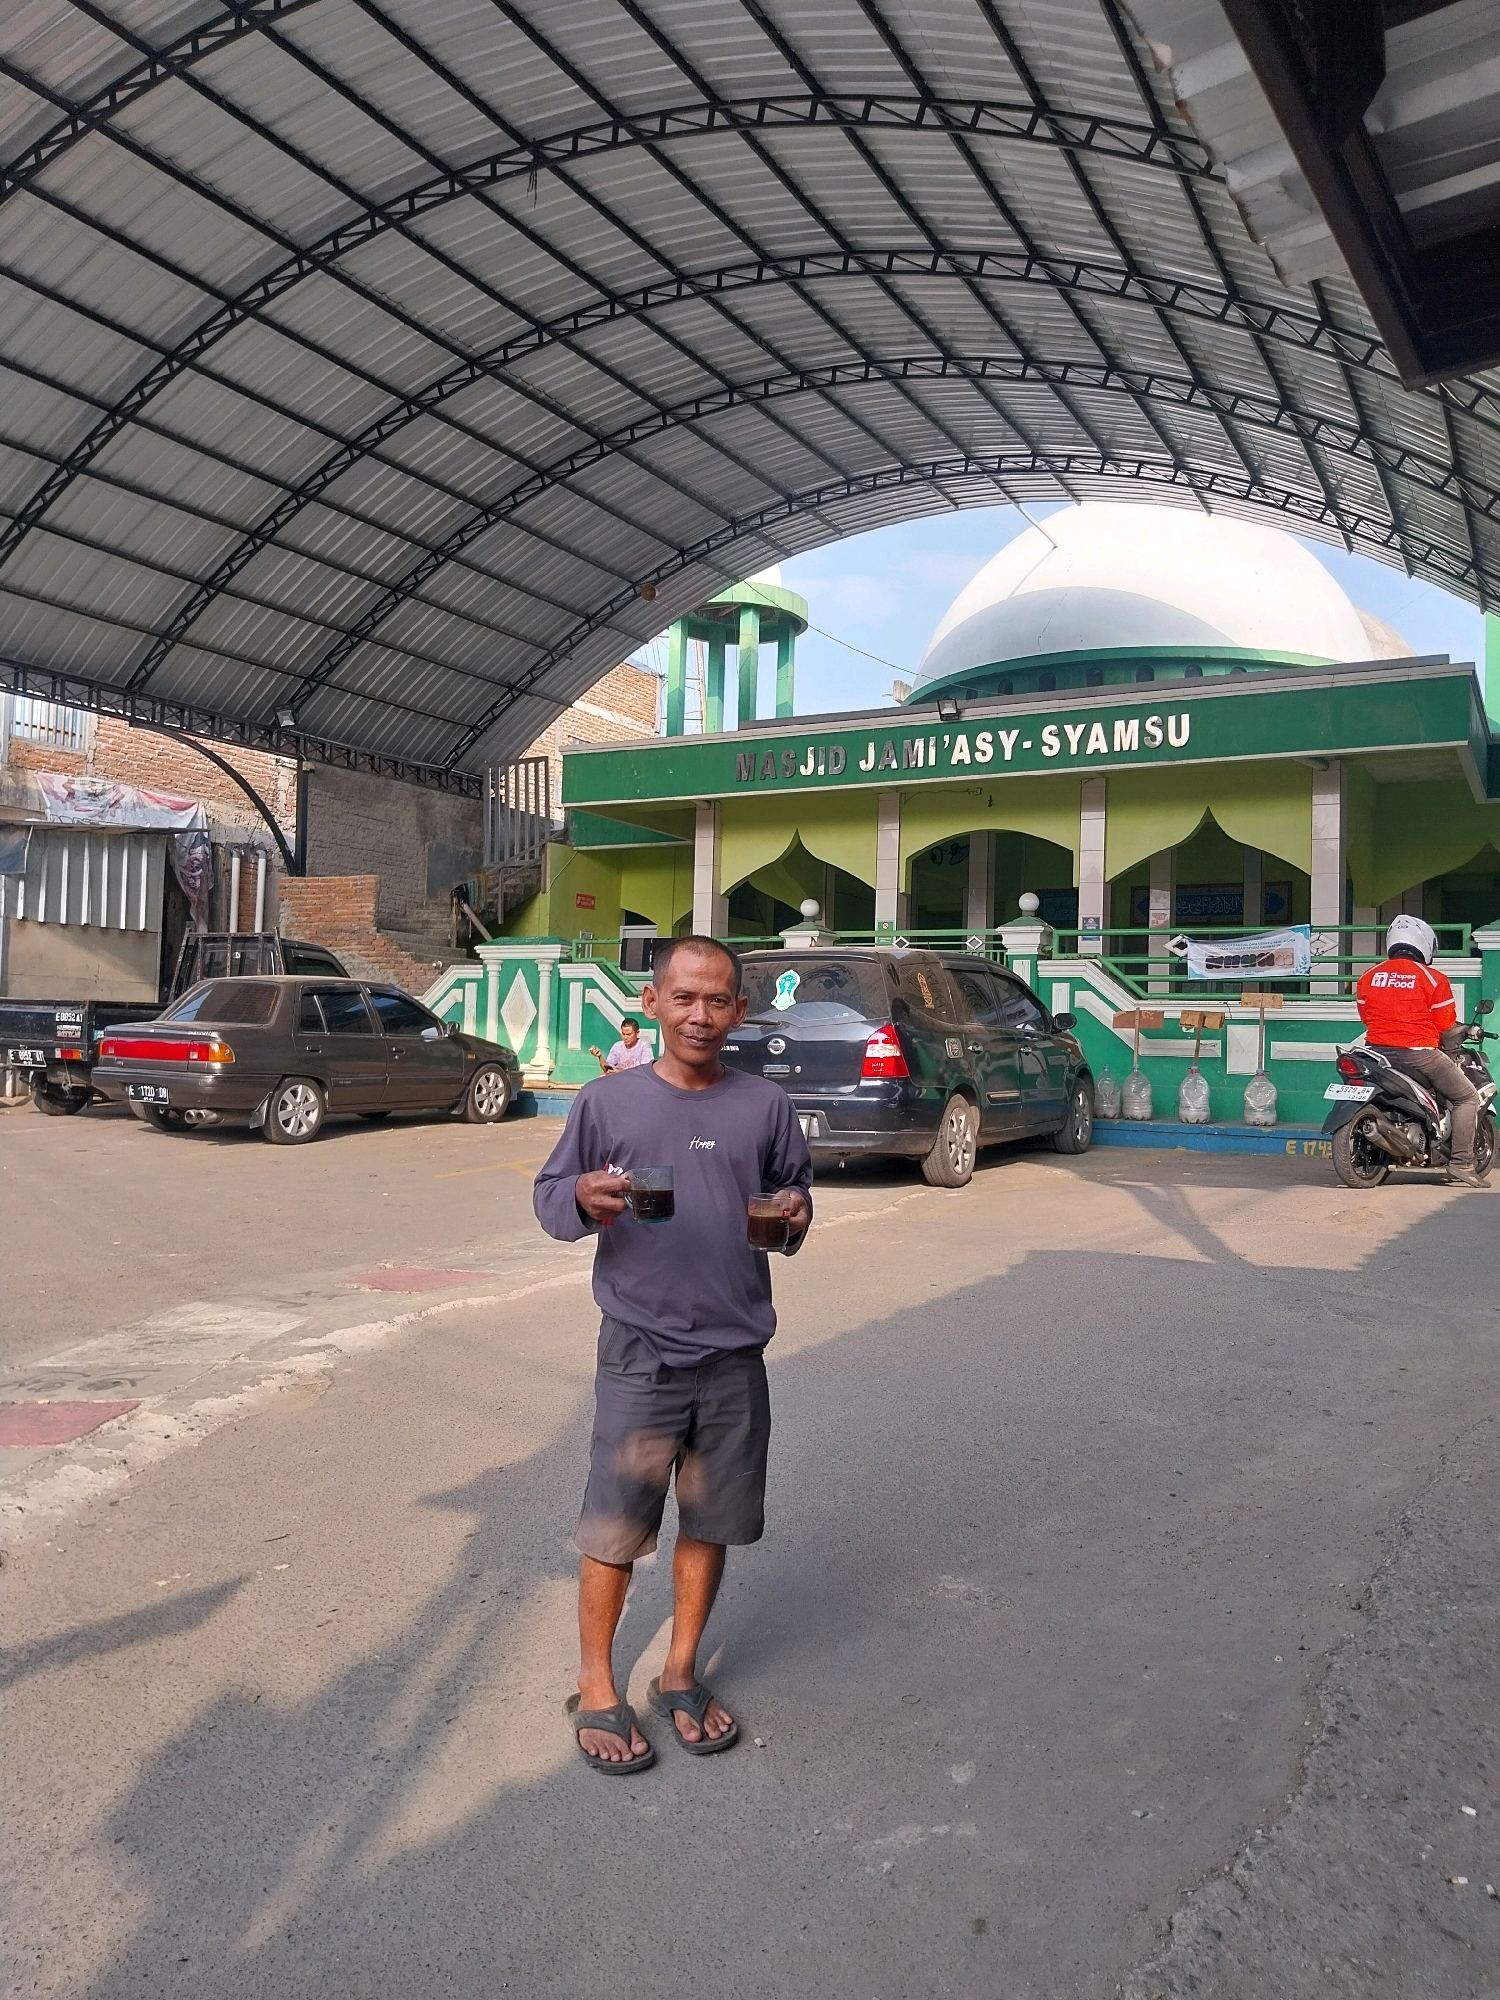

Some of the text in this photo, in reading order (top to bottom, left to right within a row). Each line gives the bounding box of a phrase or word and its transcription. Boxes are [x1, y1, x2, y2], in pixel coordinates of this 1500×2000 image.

[735, 746, 846, 782] MASJID
[1390, 972, 1416, 980] Shopee
[1387, 979, 1415, 989] Food
[1329, 1084, 1335, 1092] E
[1286, 1140, 1297, 1155] E
